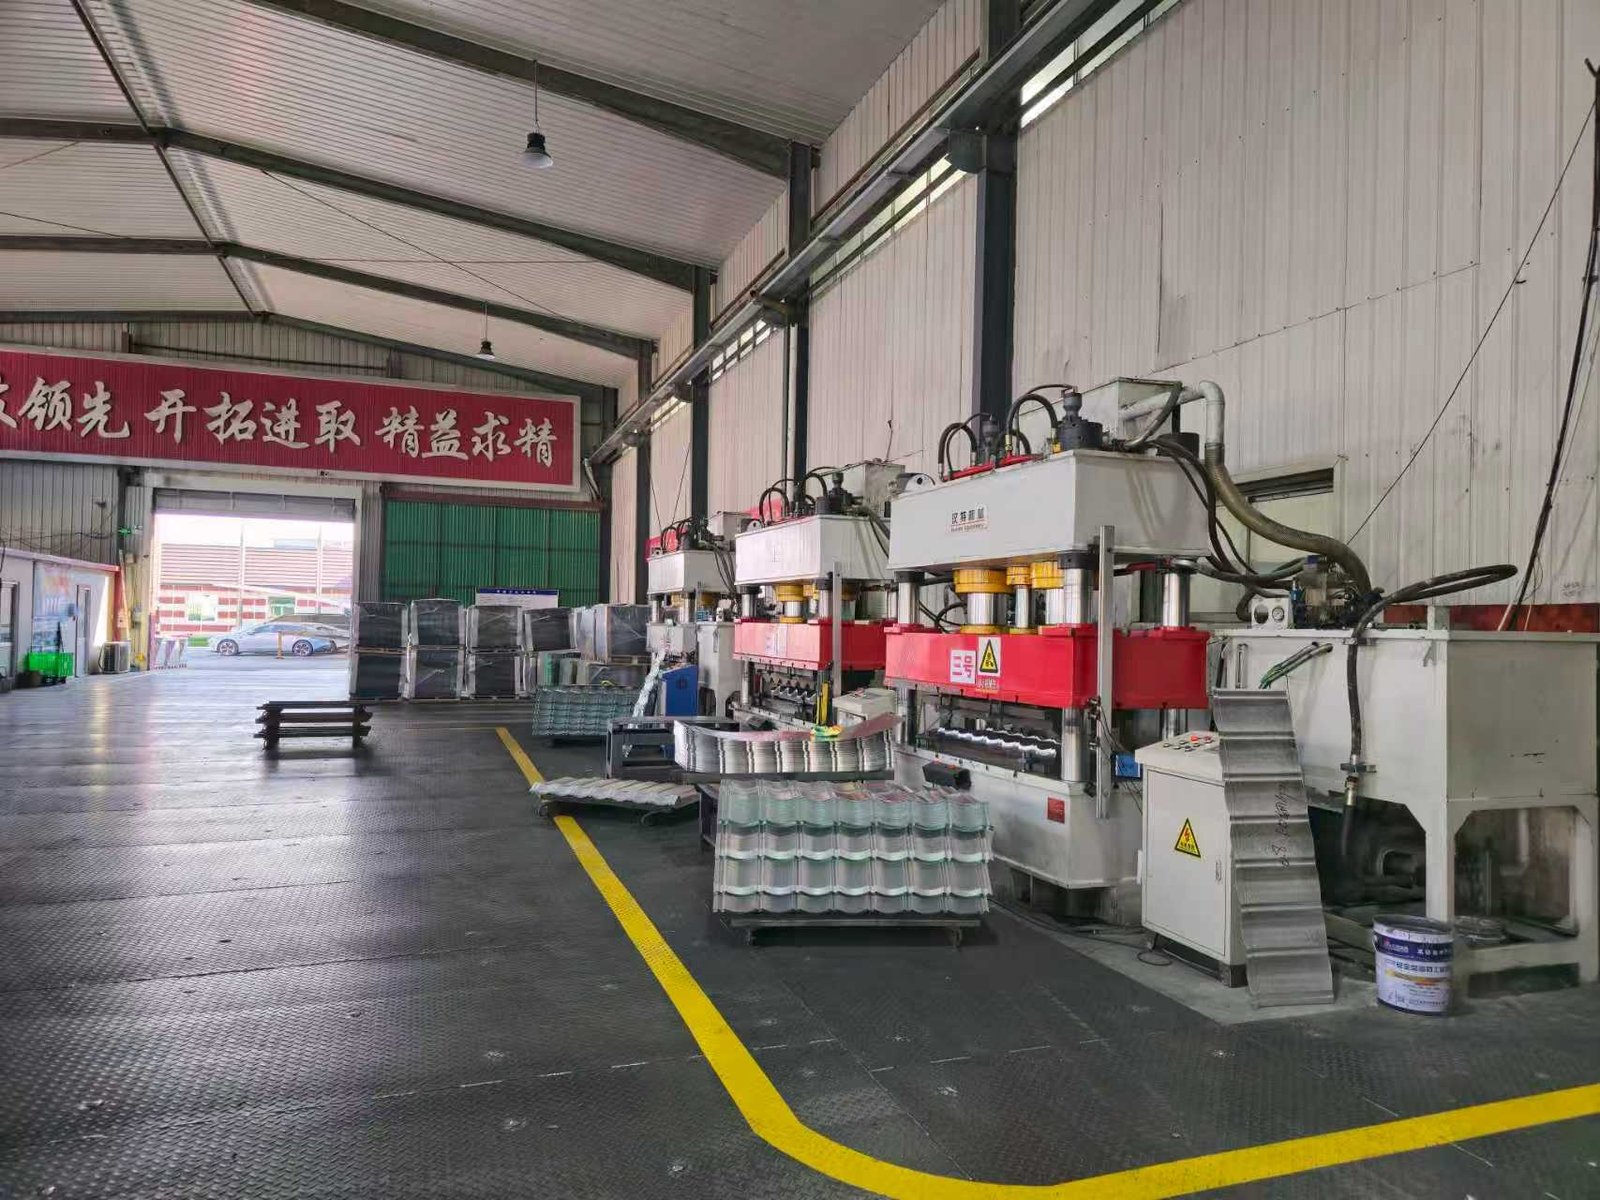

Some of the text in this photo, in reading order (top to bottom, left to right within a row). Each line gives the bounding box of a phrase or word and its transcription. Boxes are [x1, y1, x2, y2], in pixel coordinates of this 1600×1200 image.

[144, 388, 361, 453] 开拓进取
[375, 405, 557, 467] 精益求精
